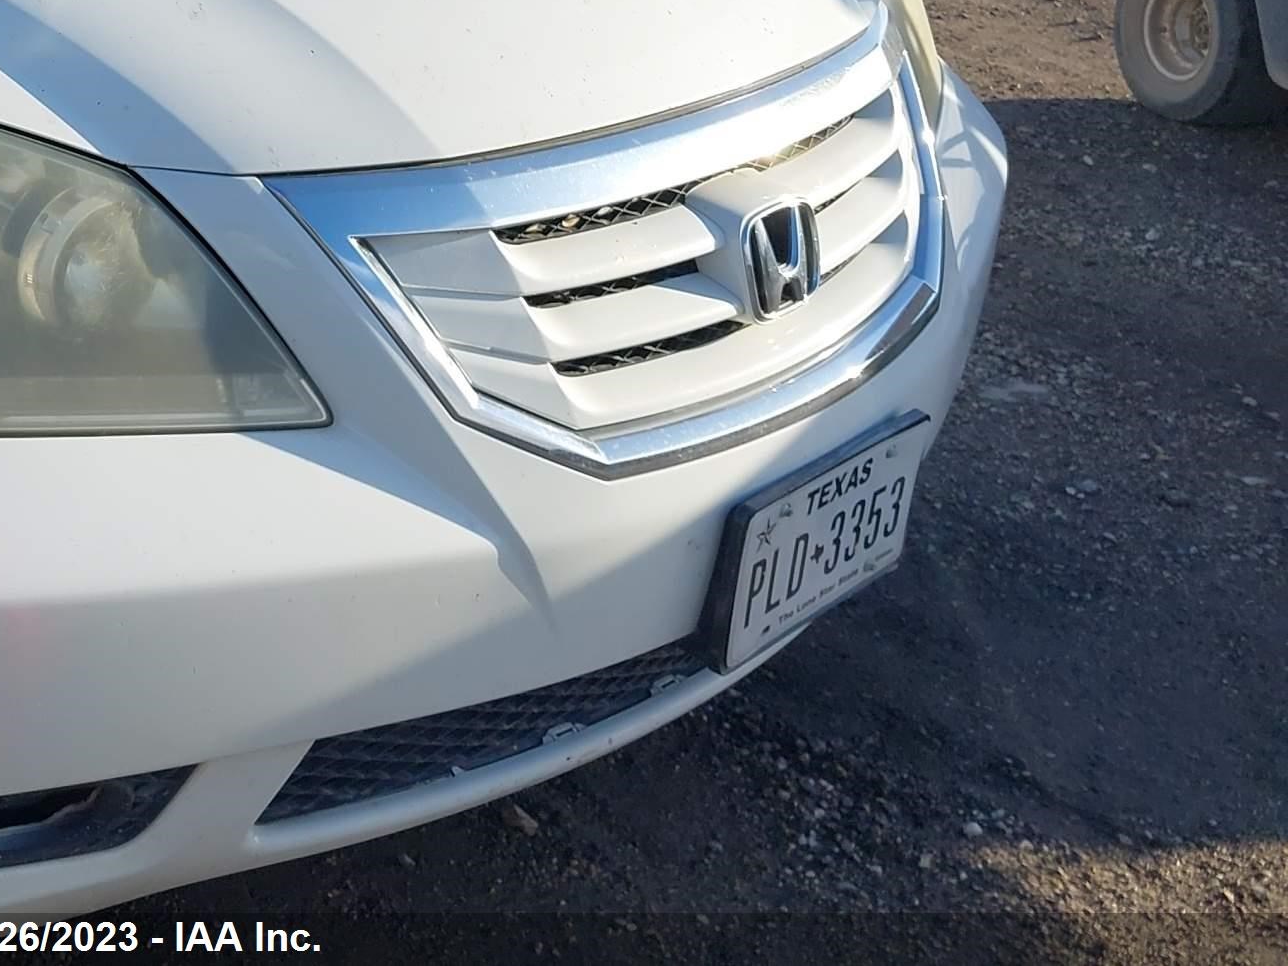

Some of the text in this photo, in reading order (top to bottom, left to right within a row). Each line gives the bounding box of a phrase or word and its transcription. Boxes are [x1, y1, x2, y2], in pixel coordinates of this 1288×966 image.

[806, 457, 874, 517] TEXAS
[743, 475, 906, 630] PLD 3353
